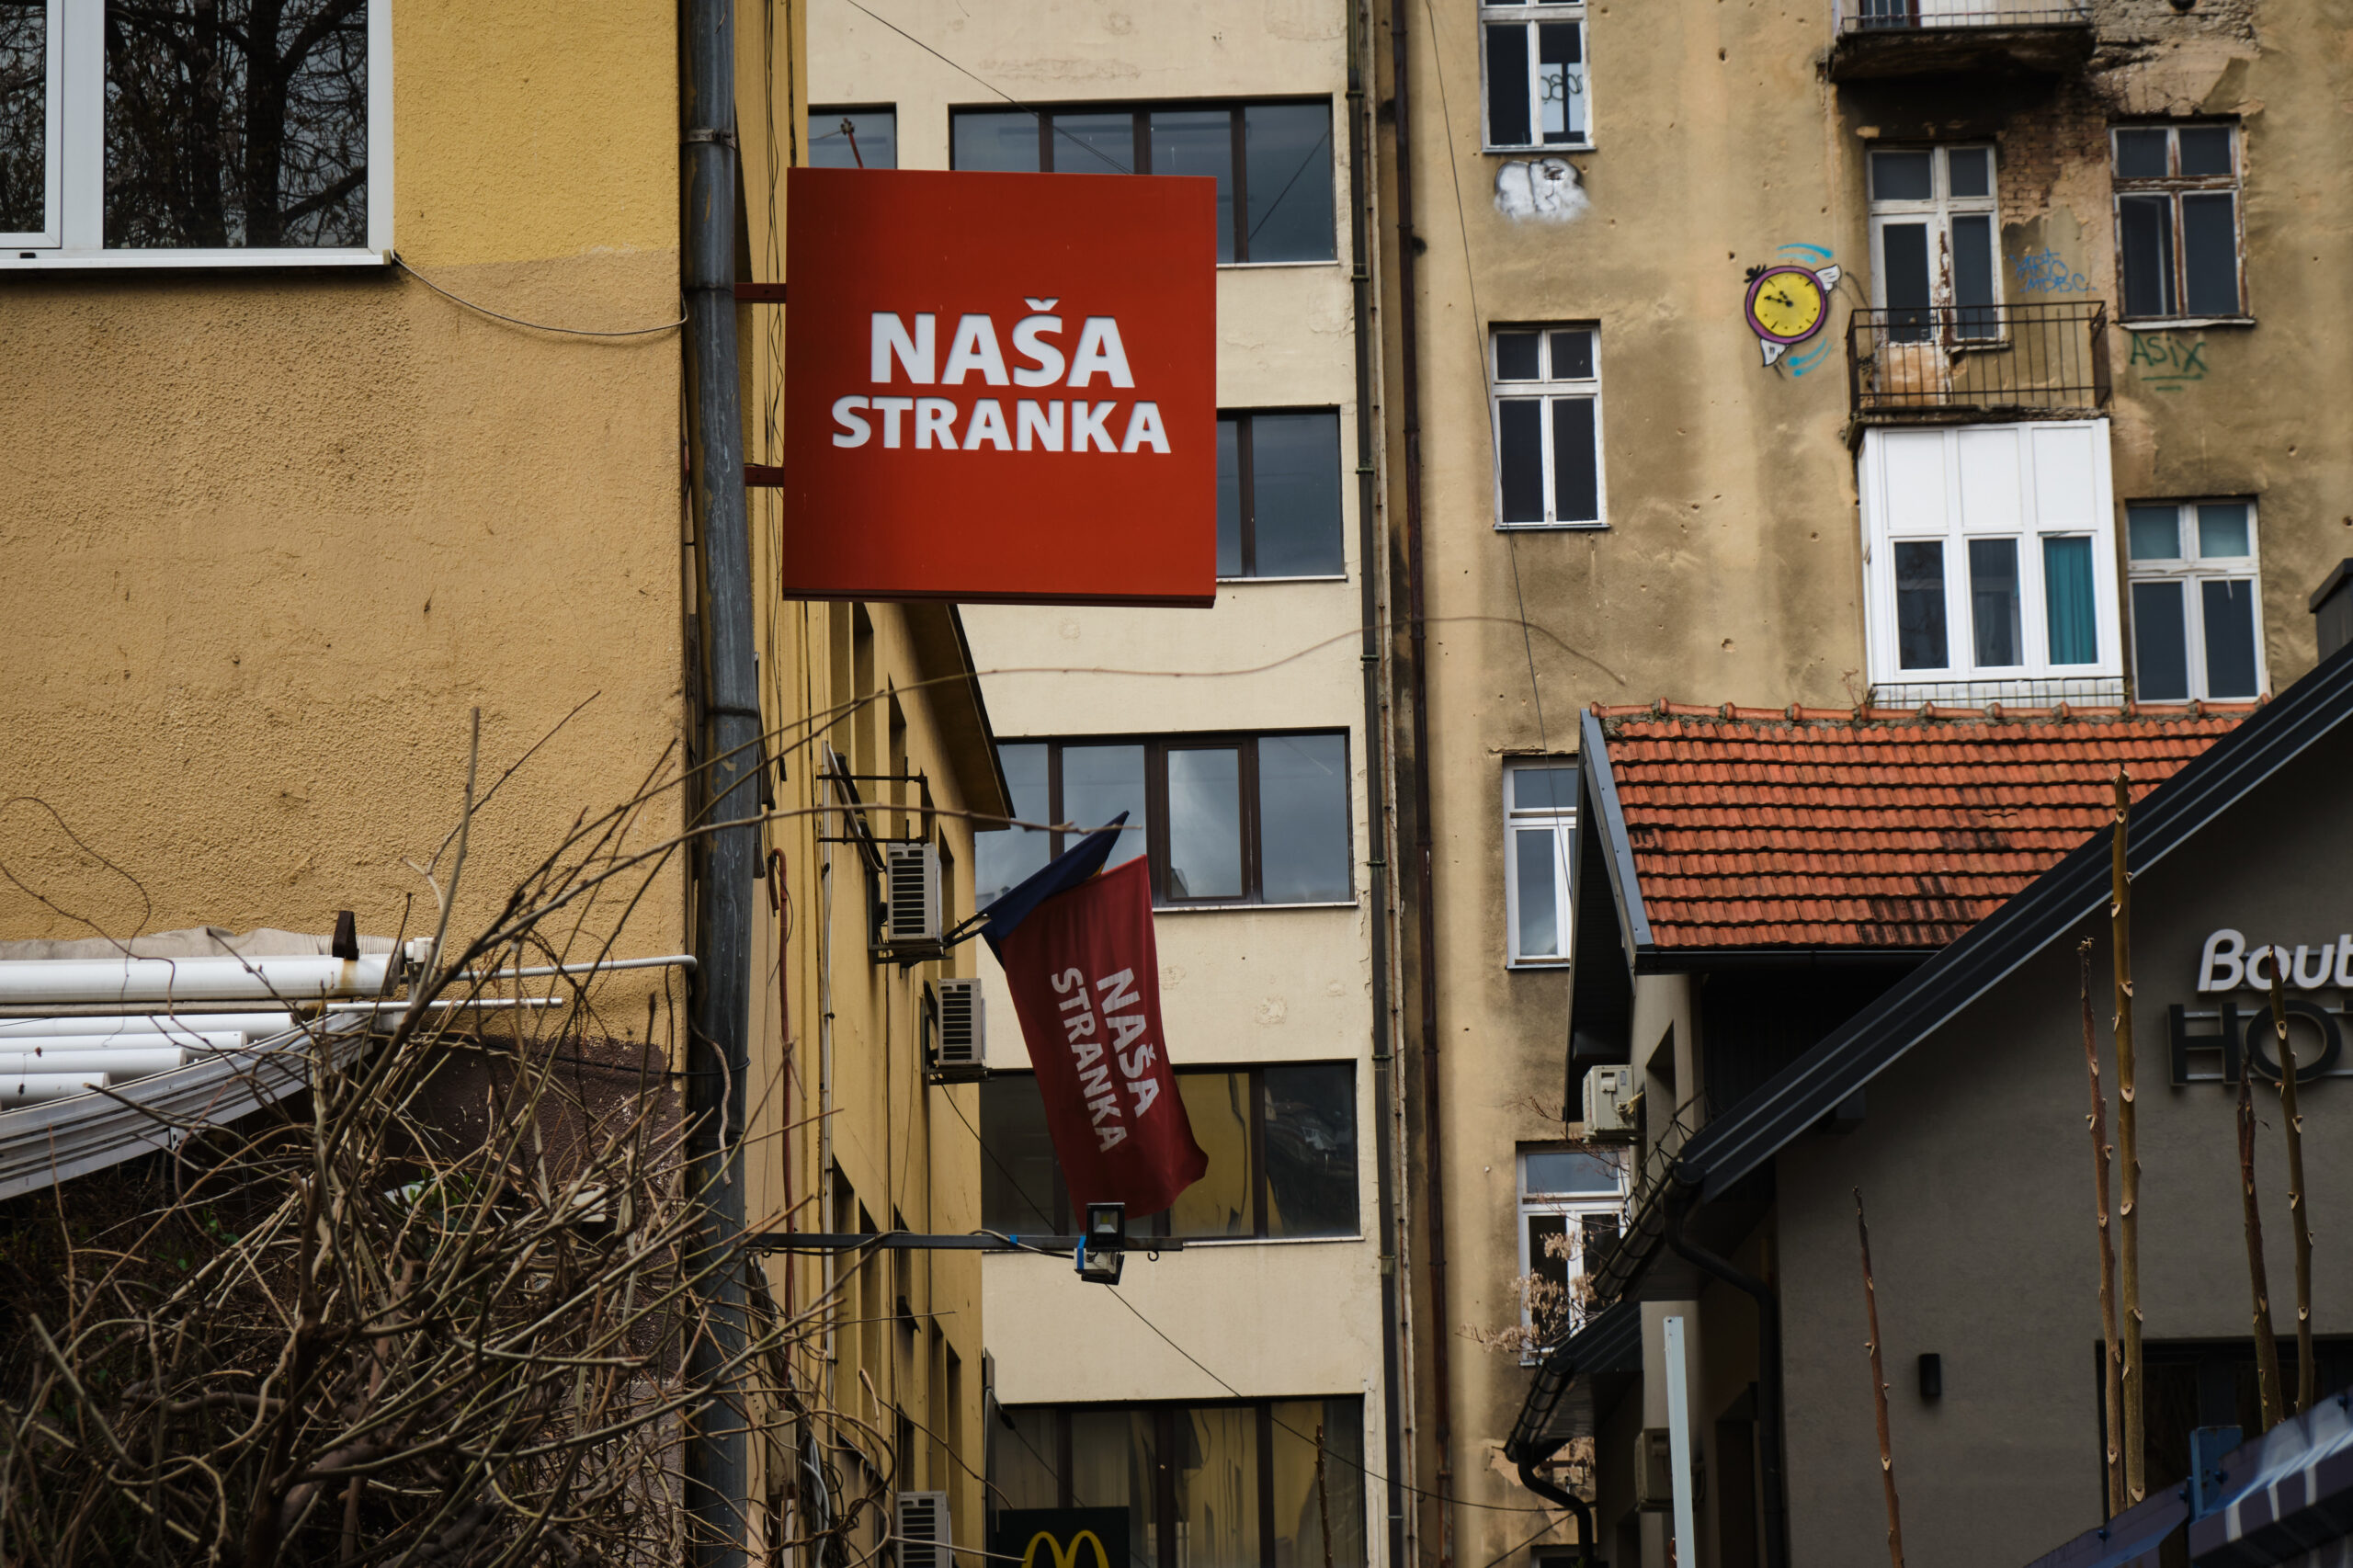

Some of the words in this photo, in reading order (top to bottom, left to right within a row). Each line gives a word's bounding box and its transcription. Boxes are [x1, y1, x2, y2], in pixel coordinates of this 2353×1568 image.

[871, 297, 1135, 388] NAŠA
[832, 395, 1171, 453] STRANKA
[1051, 968, 1128, 1153] STRANKA
[1097, 968, 1160, 1117] NAŠA
[2168, 999, 2353, 1086] HO
